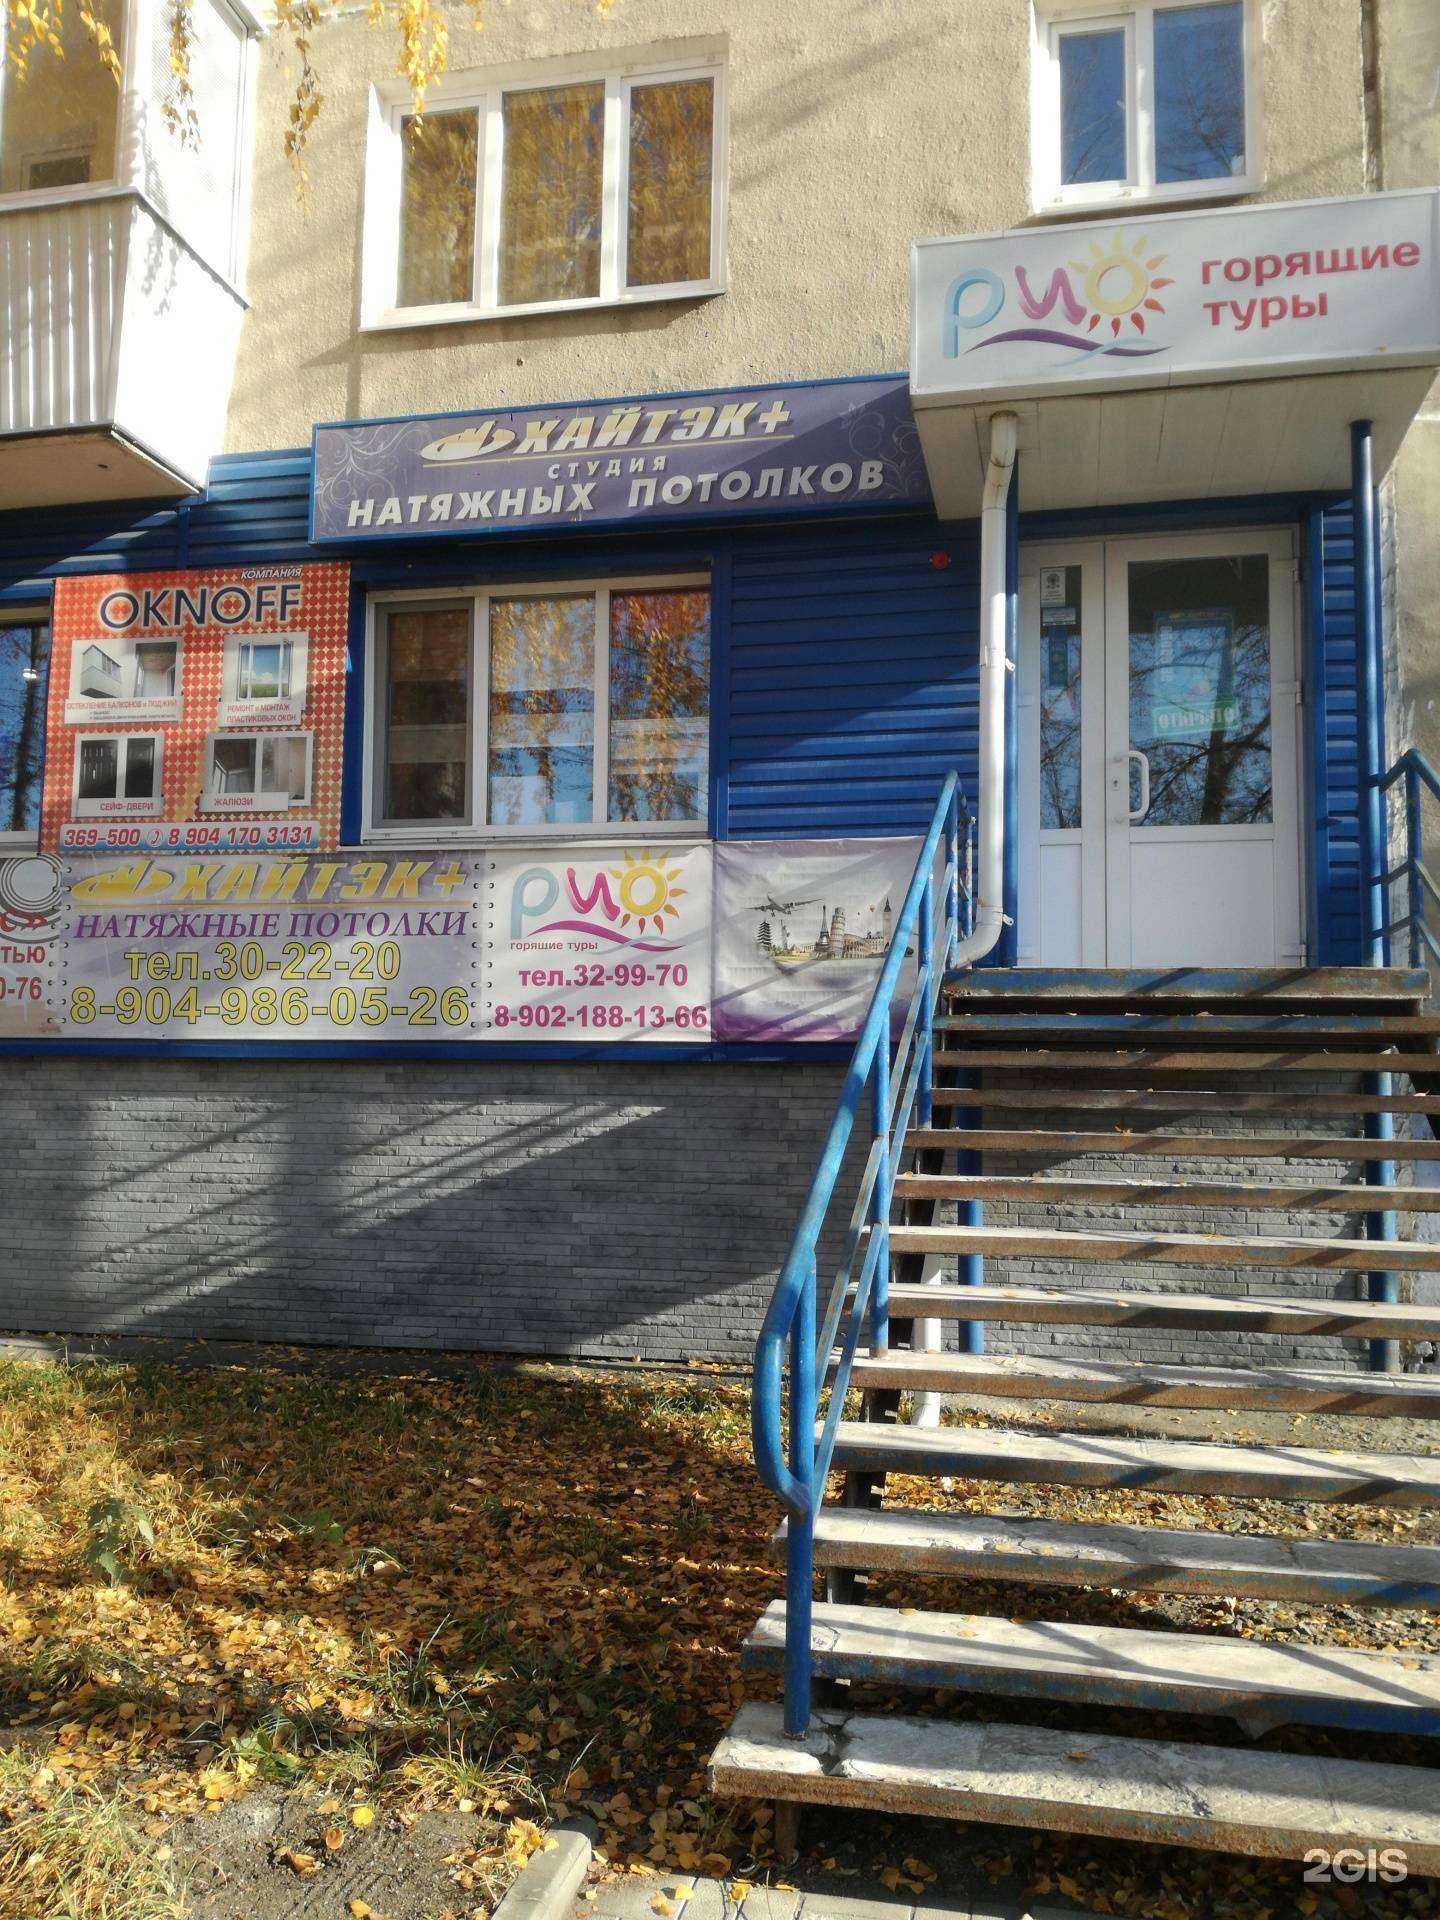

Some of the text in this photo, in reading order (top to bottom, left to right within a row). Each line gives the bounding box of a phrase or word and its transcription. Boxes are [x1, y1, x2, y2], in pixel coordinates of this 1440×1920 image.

[1203, 290, 1328, 331] туры
[547, 455, 667, 480] СТУДИЯ
[346, 460, 885, 527] НАТЯЖНЫХ ПОТОЛКОВ
[241, 568, 301, 580] КОМПАНИЯ
[100, 583, 301, 629] OKNOFF
[100, 802, 154, 812] СЕЙФ-ДВЕРИ
[214, 797, 253, 806] ЖАЛЮЗИ
[64, 826, 313, 846] 369-500 8 904 170 3131
[73, 911, 280, 939] НАТЯЖНЫЕ
[286, 910, 470, 937] ПОТОЛКИ
[568, 942, 598, 952] туры
[124, 941, 402, 981] тел.30-22-20
[518, 964, 688, 987] тел.32-99-70
[70, 986, 469, 1026] 8-904-986-05-26
[494, 1004, 708, 1029] 8-902-188-13-66
